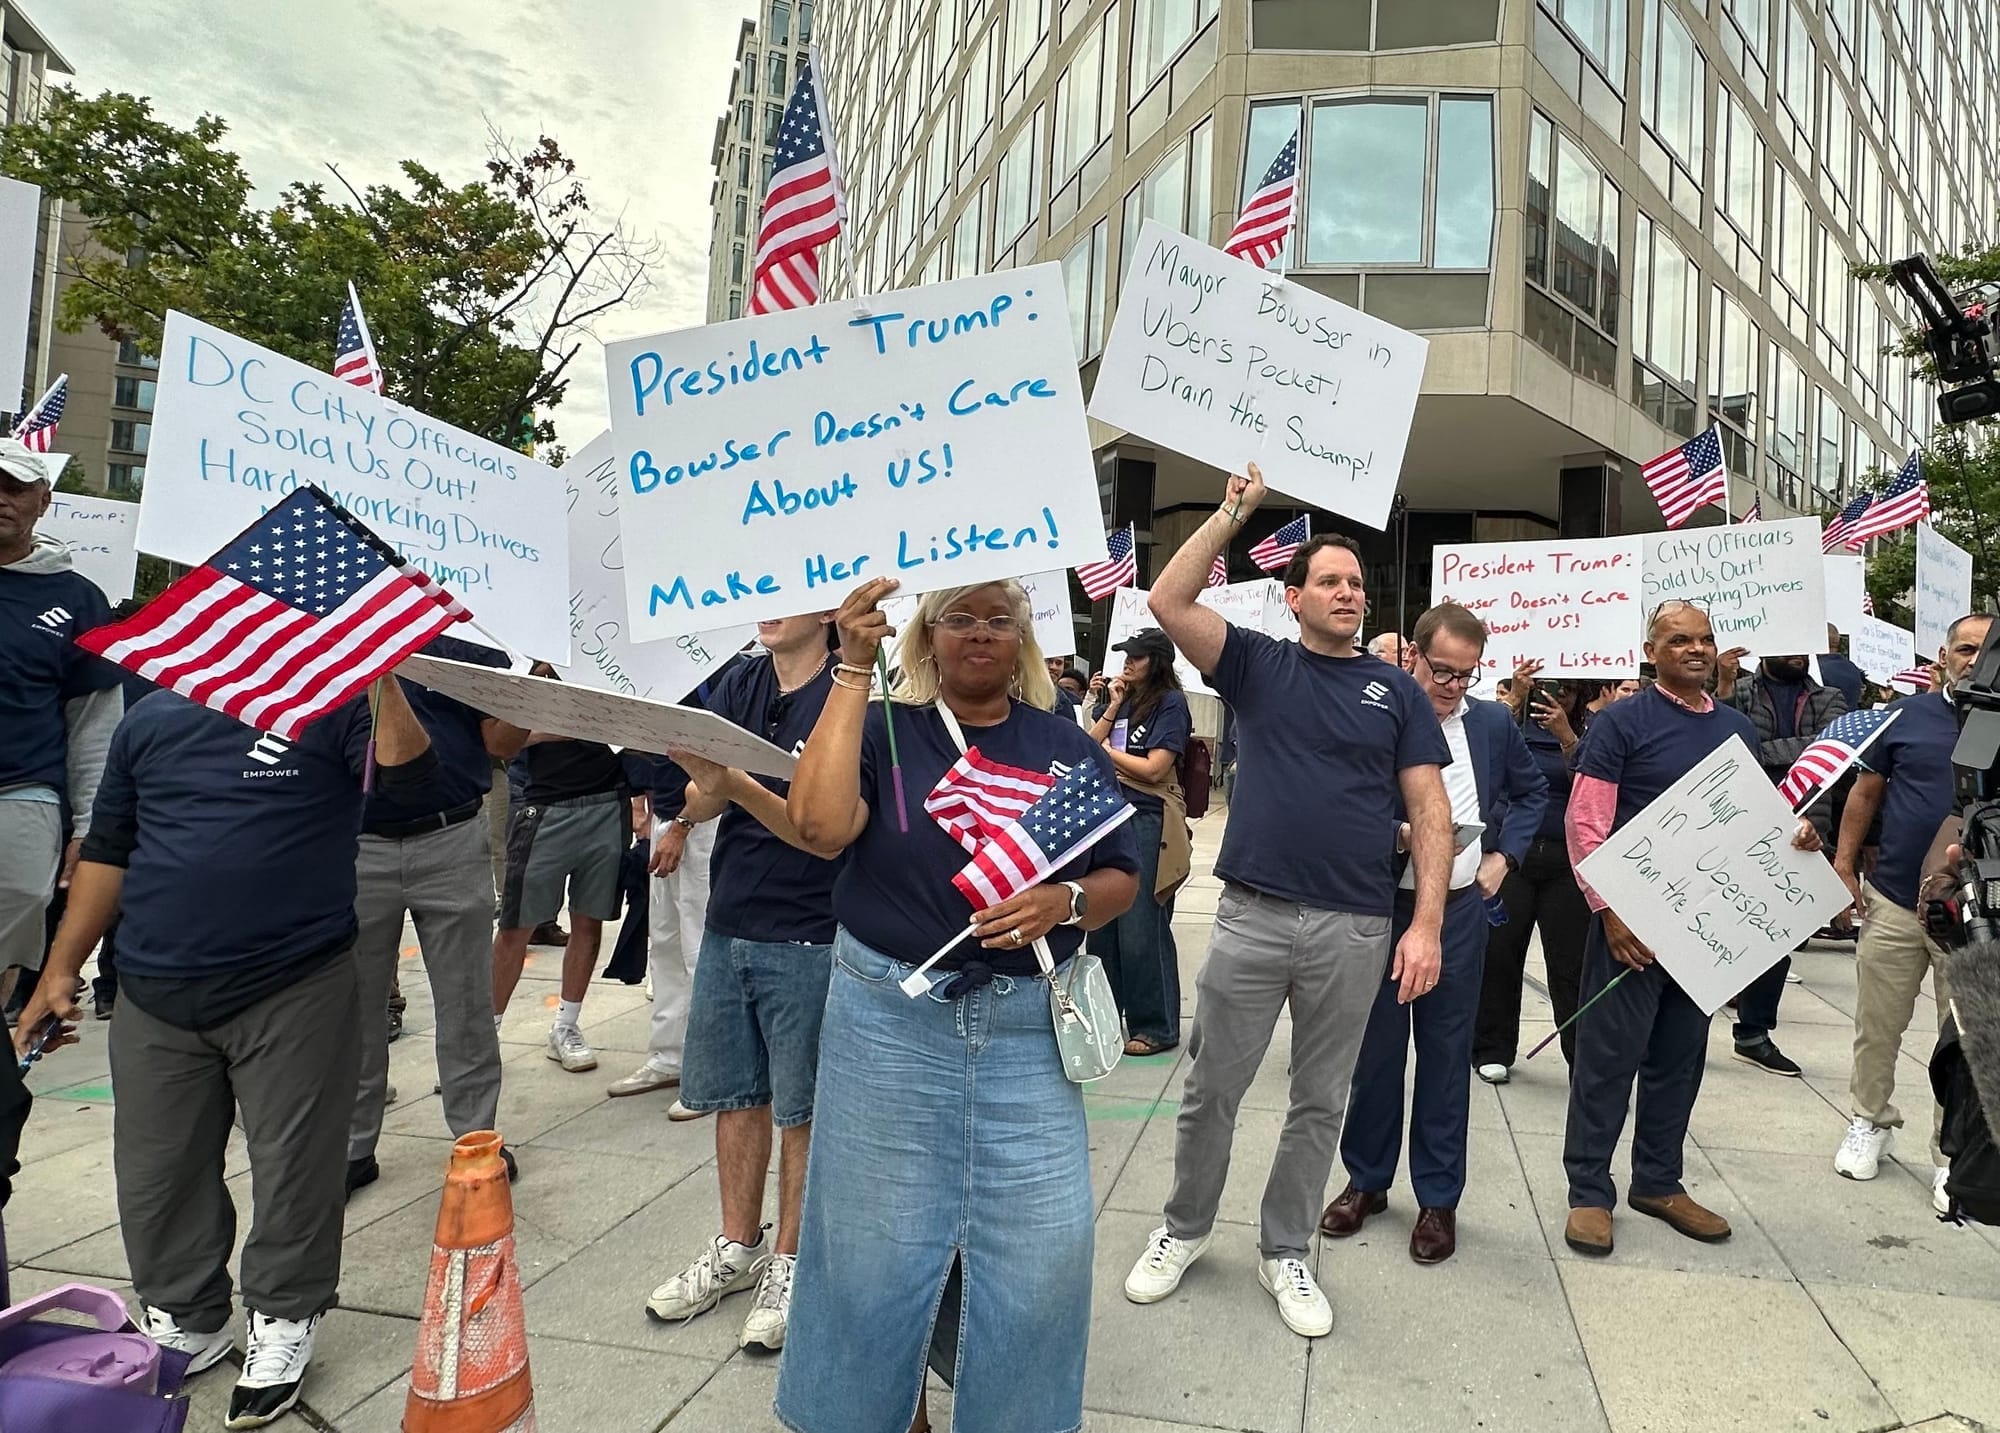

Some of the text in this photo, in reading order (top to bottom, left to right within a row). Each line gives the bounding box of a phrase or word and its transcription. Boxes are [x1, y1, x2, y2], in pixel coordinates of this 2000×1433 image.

[1145, 239, 1392, 369] Mayor Bowser in
[630, 289, 1039, 417] President Trump:
[1143, 297, 1342, 405] Uber's Pocket!
[187, 335, 518, 481] DC City Officials
[1141, 354, 1373, 482] Drain the Swamp!
[237, 410, 477, 504] Sold Us Out!
[629, 429, 792, 494] Bowser
[814, 402, 926, 447] Doesn't
[947, 378, 1057, 416] Care
[50, 501, 126, 524] Trump:
[742, 472, 858, 525] About
[448, 512, 540, 563] Drivers
[649, 506, 1059, 617] Make Her Listen!
[1657, 539, 1701, 566] City
[1442, 552, 1632, 585] President Trump:
[1641, 553, 1765, 595] Sold Us Out!
[1743, 579, 1804, 600] Drivers
[1510, 591, 1570, 609] Doesn't
[1581, 590, 1629, 605] Care
[1711, 606, 1768, 634] Trump!
[1559, 649, 1635, 668] Listen!
[242, 769, 299, 779] EMPOWER
[1657, 805, 1688, 837] in
[1687, 758, 1815, 906] Mayor Bowser
[1622, 836, 1749, 967] Drain the Swamp!
